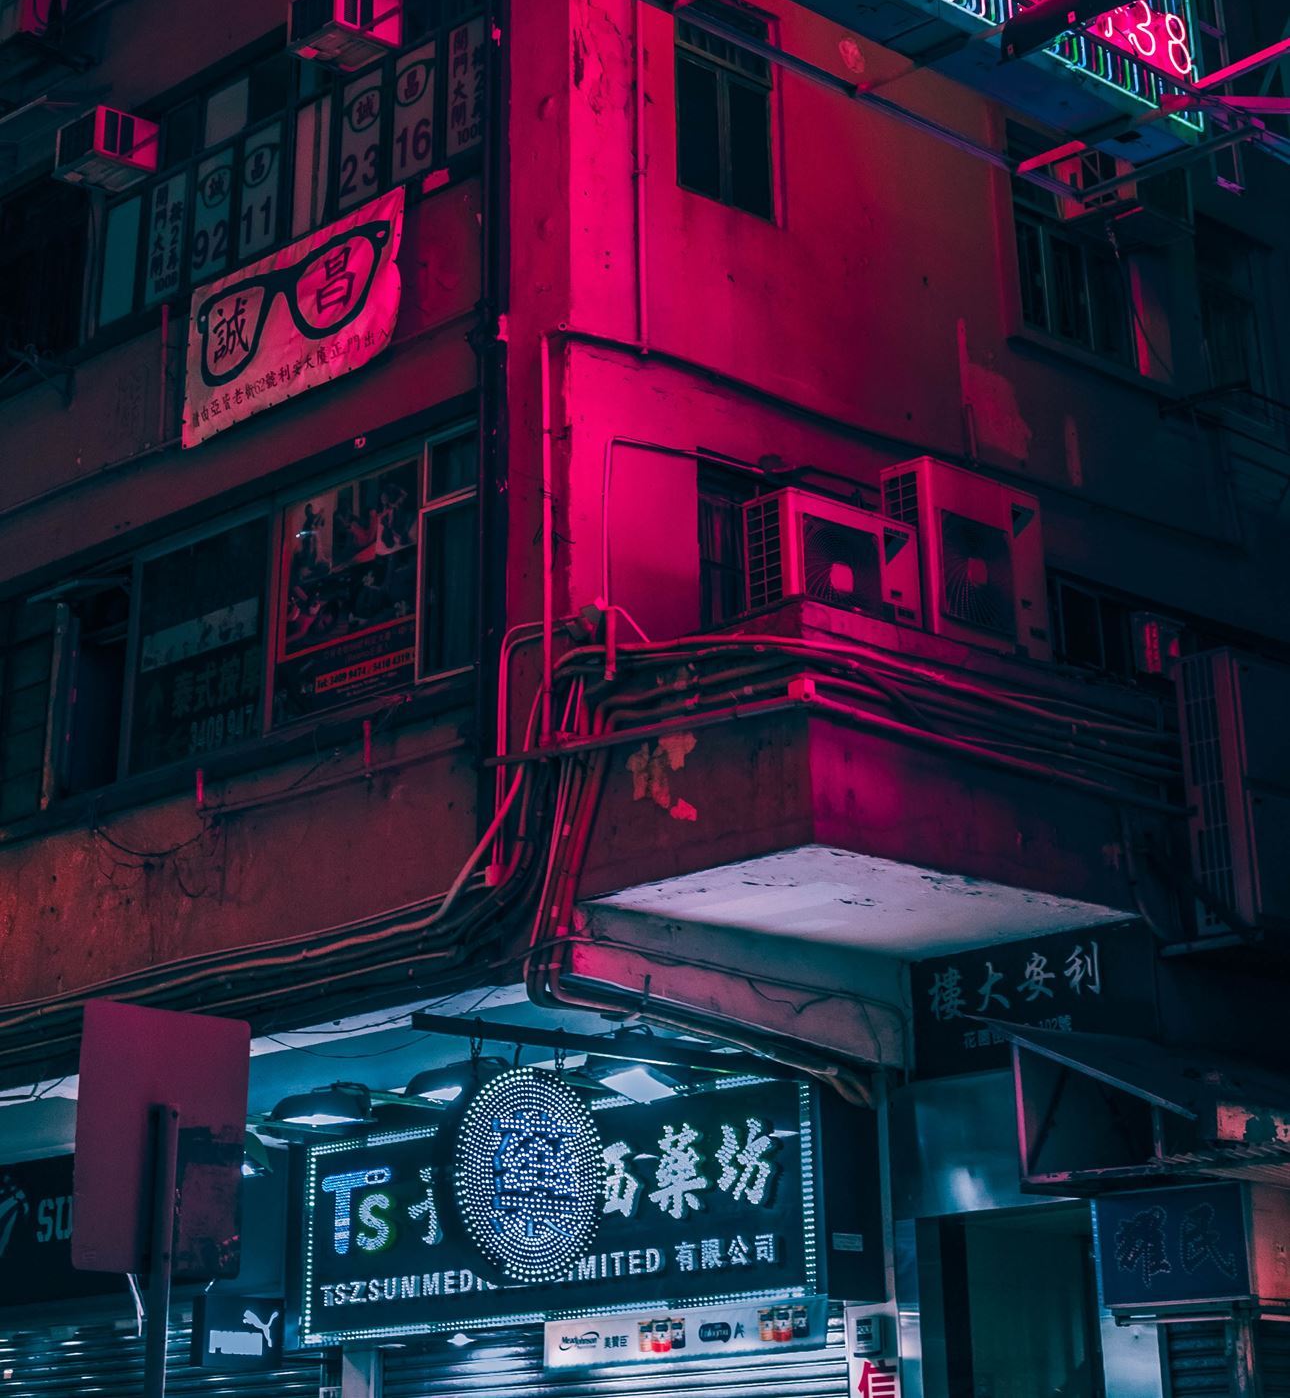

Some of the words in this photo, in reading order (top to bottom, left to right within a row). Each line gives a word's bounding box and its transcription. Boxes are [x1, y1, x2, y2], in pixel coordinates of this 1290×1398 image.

[192, 219, 228, 269] 92
[241, 196, 271, 244] 11
[340, 144, 379, 197] 23
[396, 118, 432, 168] 16
[213, 297, 249, 363] 誠
[316, 247, 355, 314] 昌
[674, 1234, 777, 1271] 有限公司
